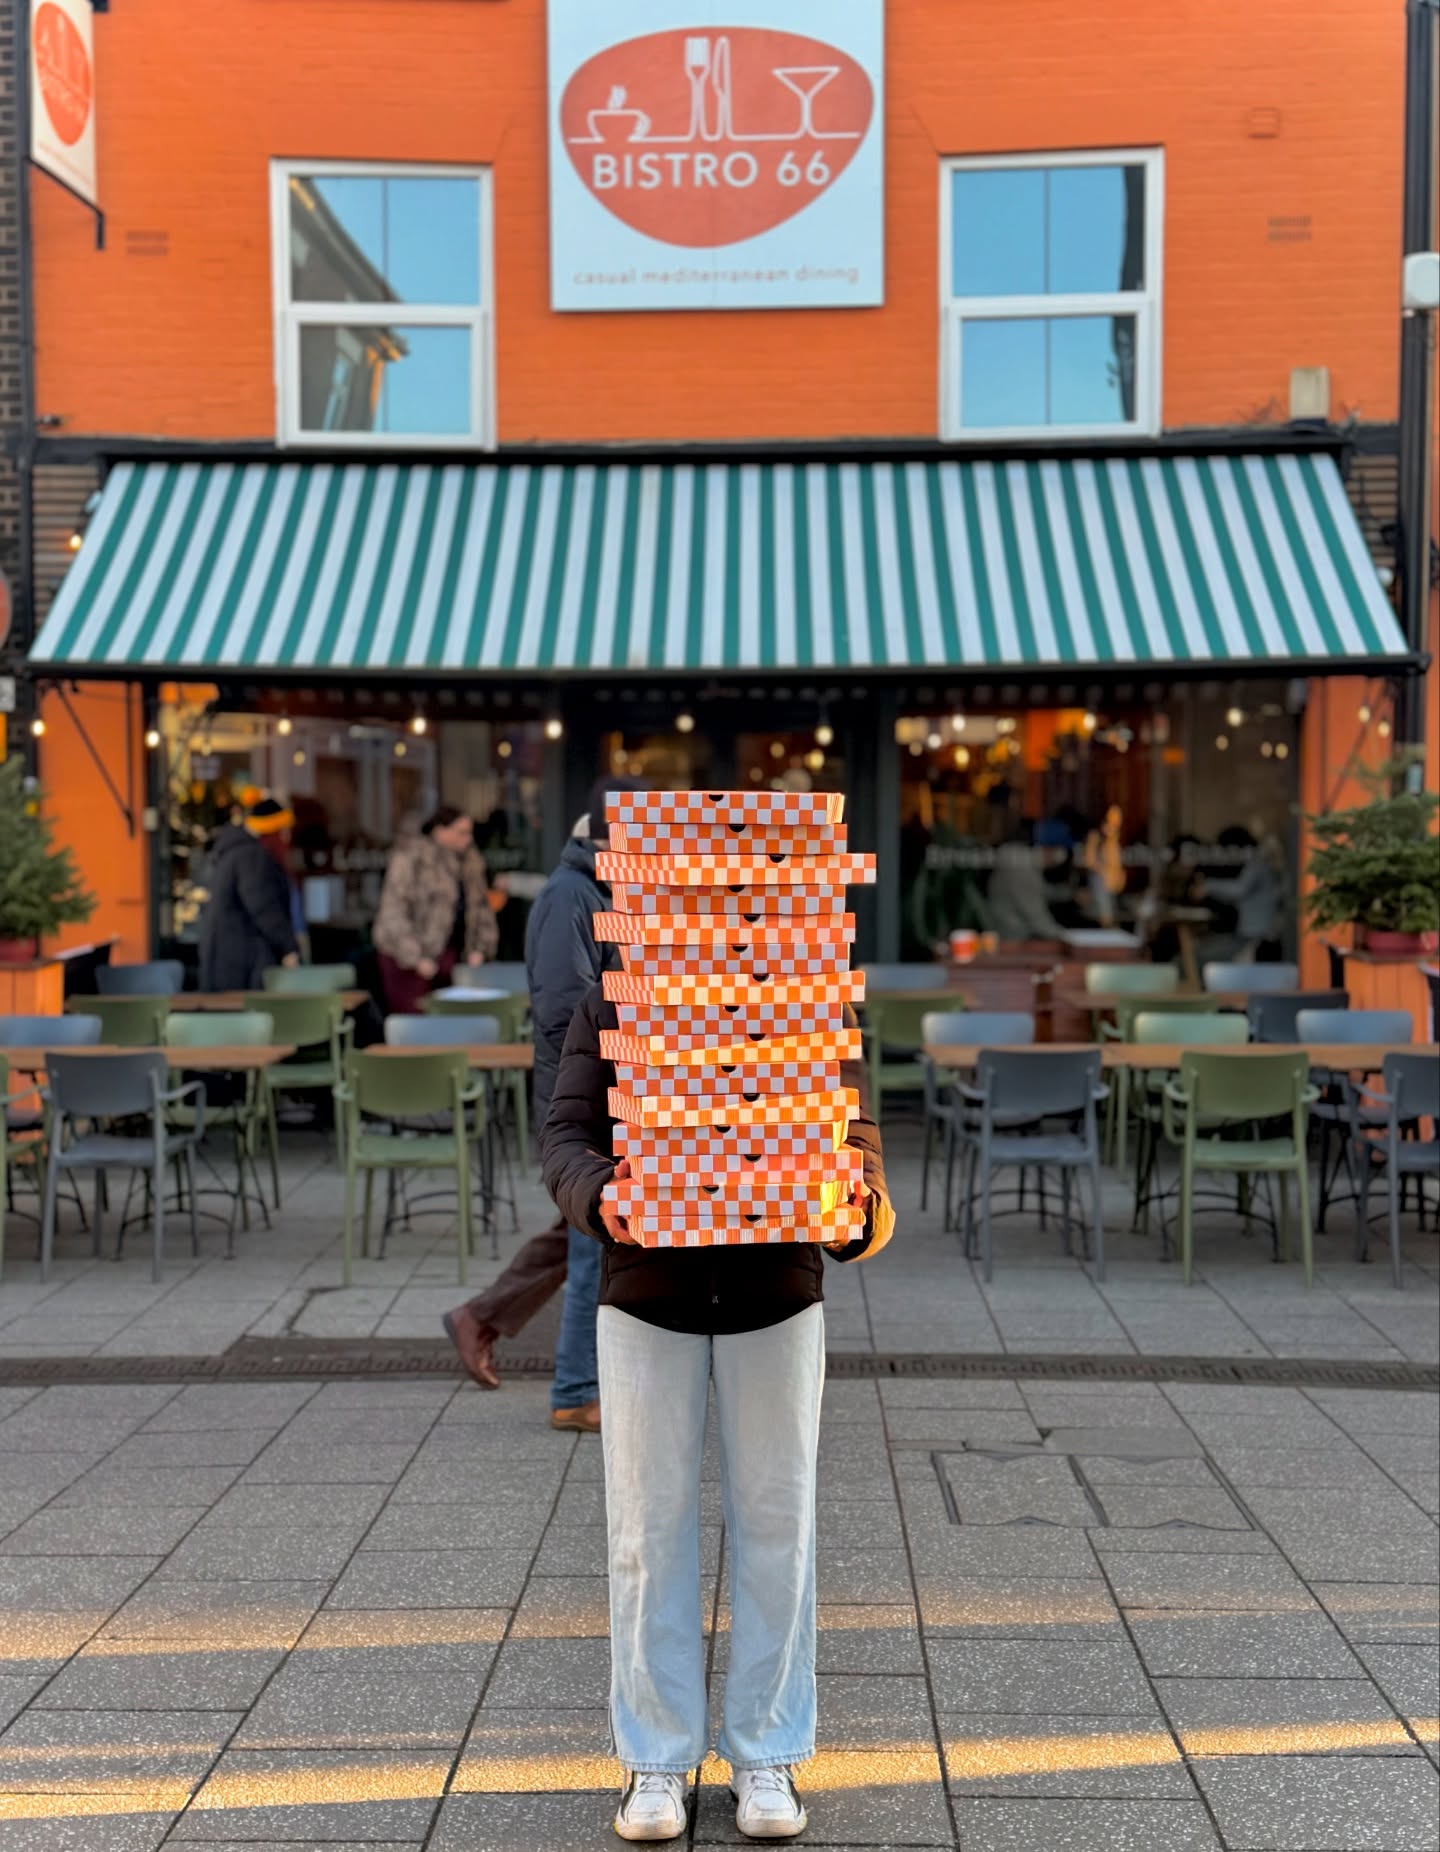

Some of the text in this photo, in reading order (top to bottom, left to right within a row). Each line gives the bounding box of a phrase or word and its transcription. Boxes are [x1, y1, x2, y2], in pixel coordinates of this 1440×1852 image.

[593, 150, 830, 189] BISTRO 66
[573, 267, 636, 285] casual
[795, 265, 859, 285] dining
